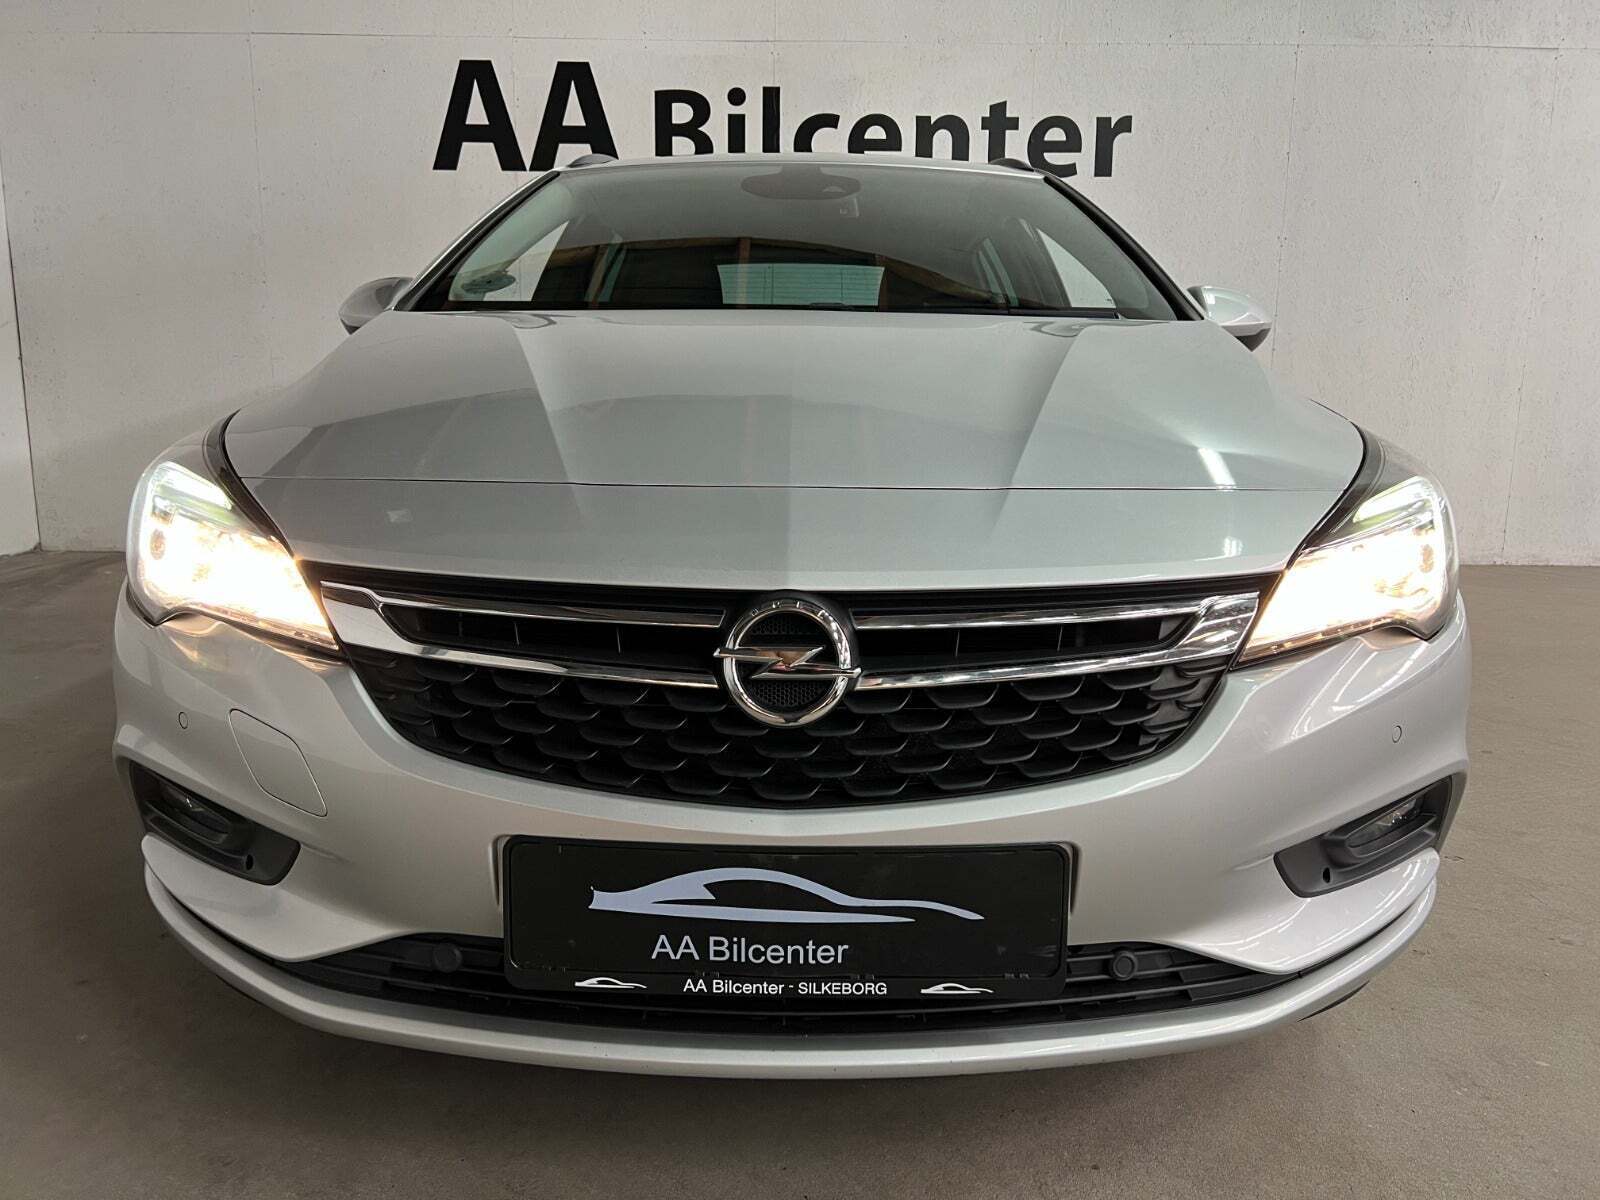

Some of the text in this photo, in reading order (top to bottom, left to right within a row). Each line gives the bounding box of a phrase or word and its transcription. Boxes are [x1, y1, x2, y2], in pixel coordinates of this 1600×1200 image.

[433, 60, 1133, 178] AA Bilcenter
[650, 934, 849, 965] AA Bilcenter
[683, 978, 708, 993] AA
[712, 979, 785, 995] Bilcenter
[797, 982, 888, 995] SILKEBORG
